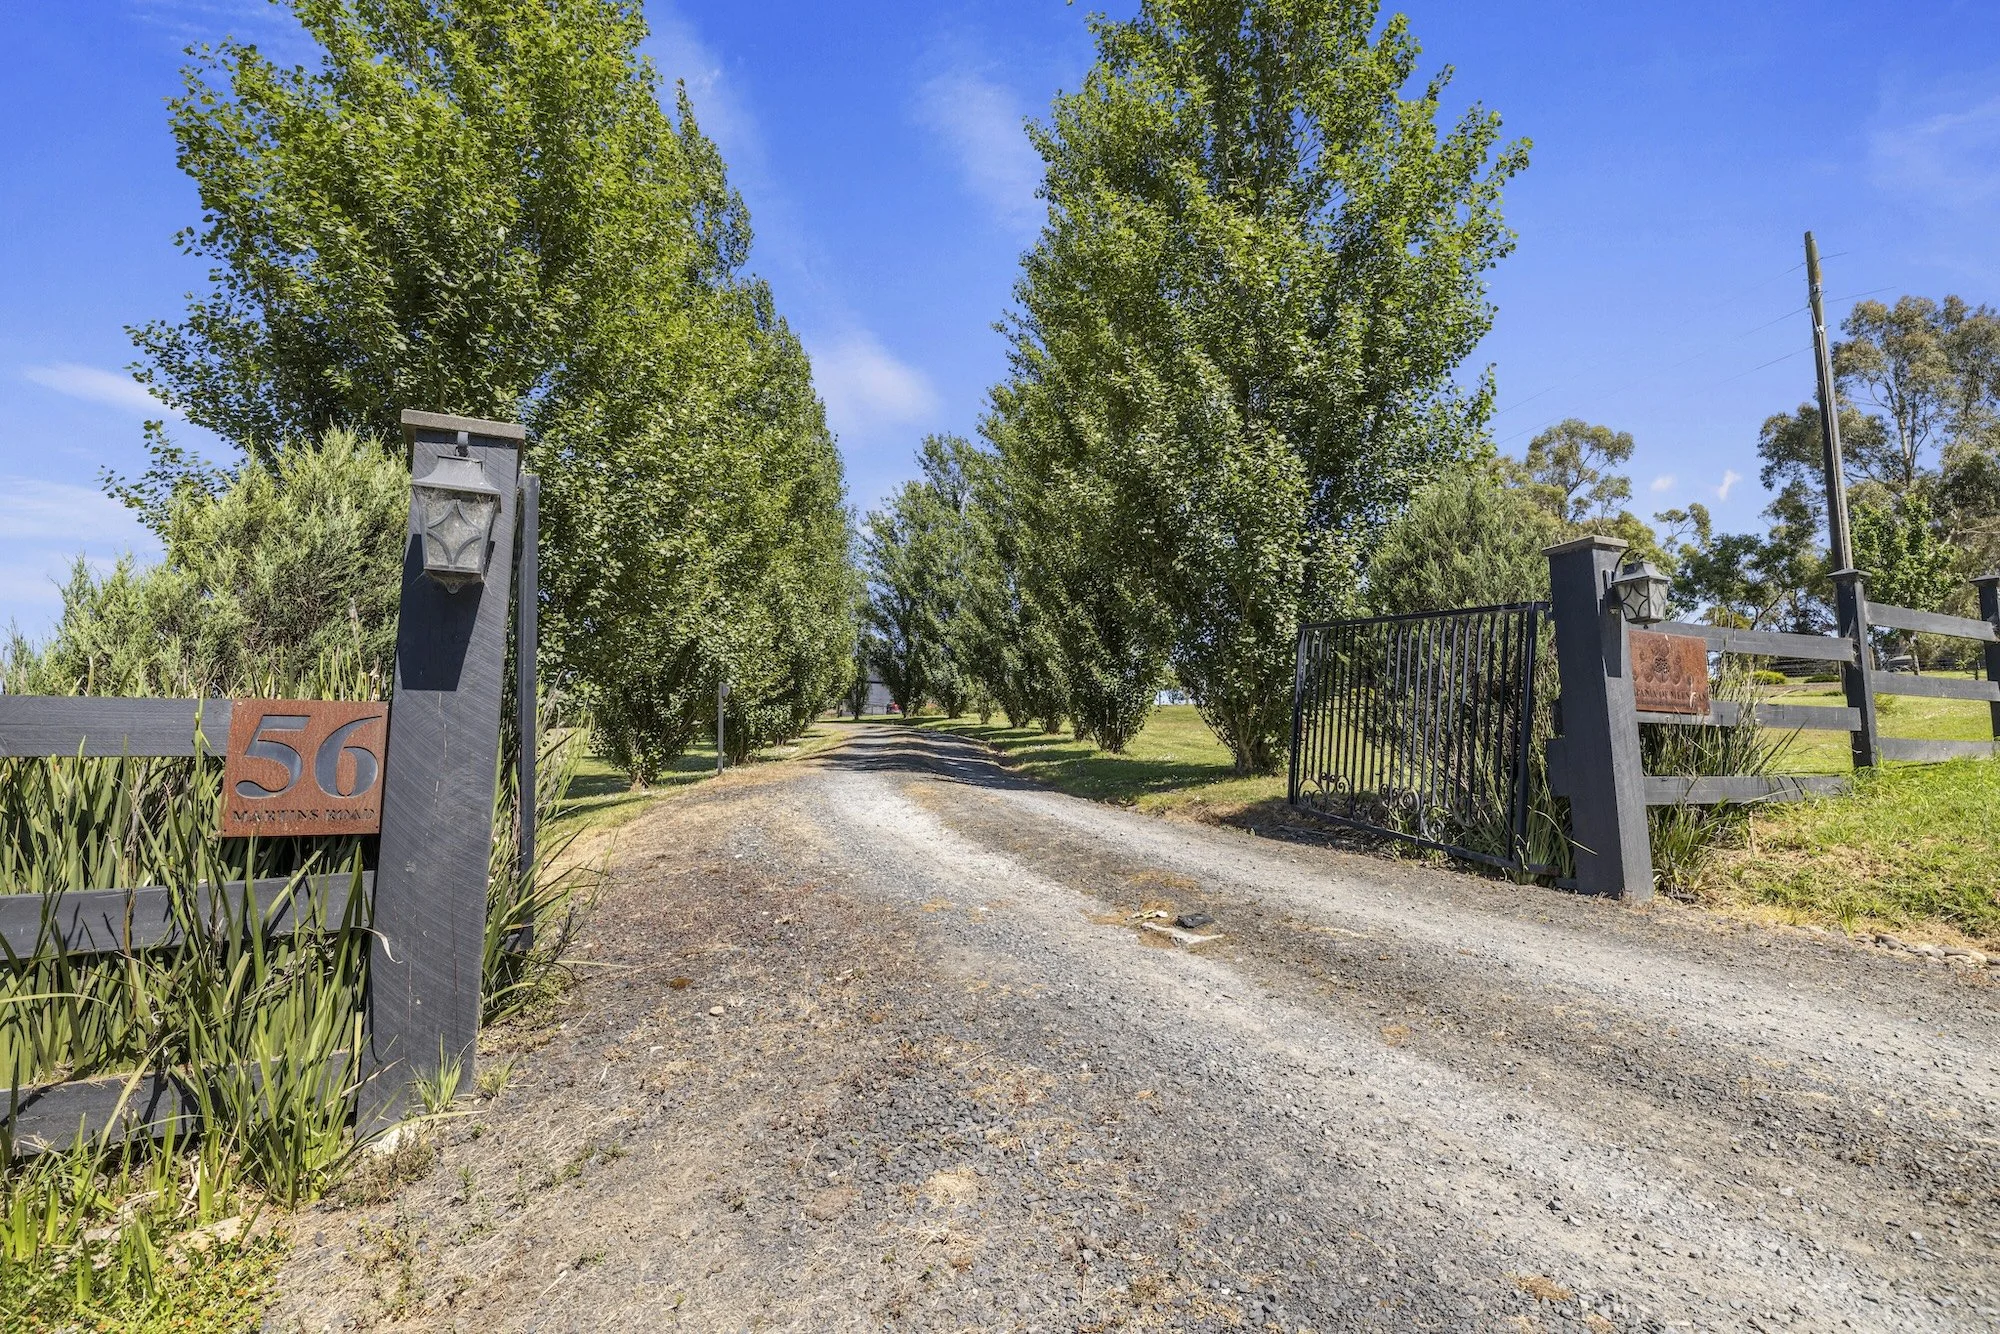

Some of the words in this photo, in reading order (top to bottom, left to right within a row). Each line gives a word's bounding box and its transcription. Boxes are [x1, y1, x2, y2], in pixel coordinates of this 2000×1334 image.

[235, 714, 383, 799] 56
[232, 809, 319, 822] MARTINS
[325, 807, 375, 821] ROAD
